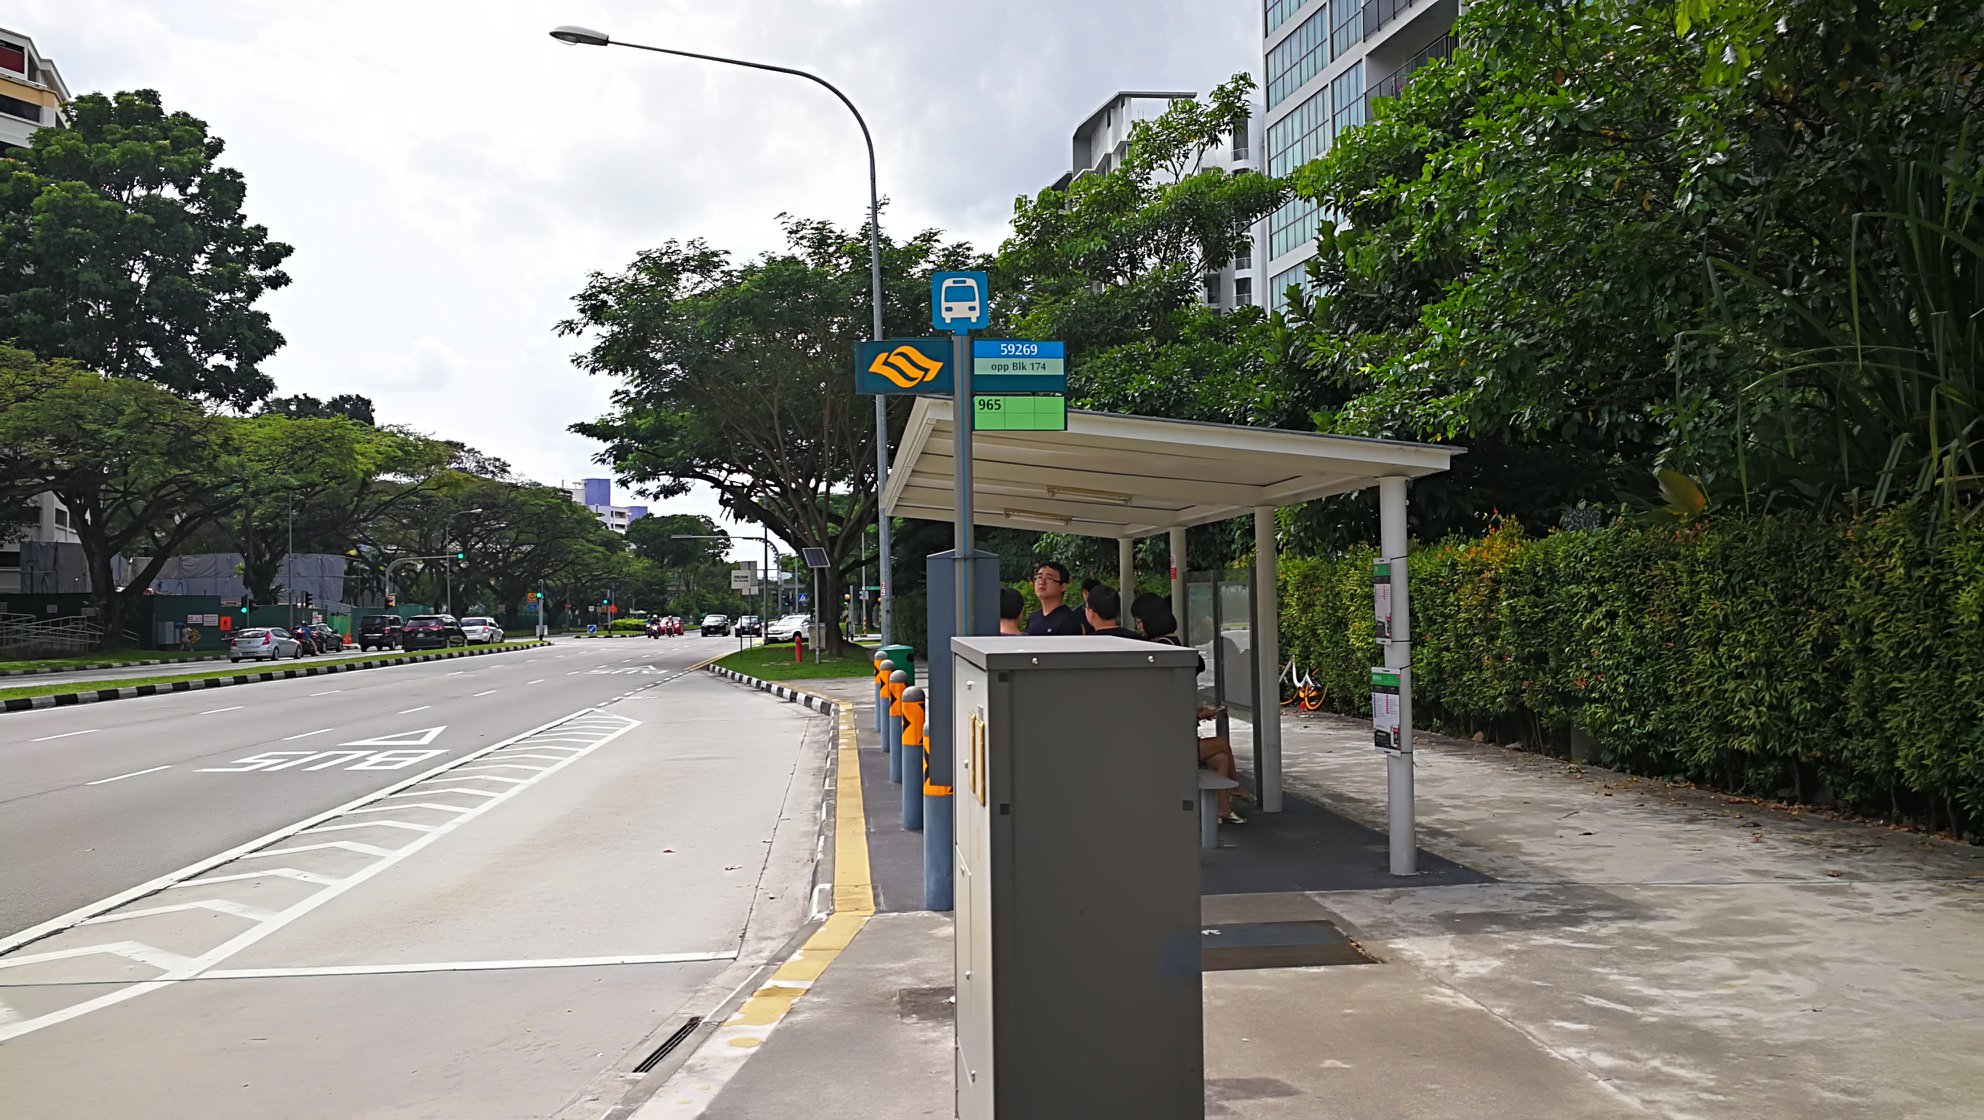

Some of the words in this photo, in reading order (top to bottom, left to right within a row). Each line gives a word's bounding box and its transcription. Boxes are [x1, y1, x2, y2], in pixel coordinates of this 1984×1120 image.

[1000, 343, 1038, 355] 59269
[991, 363, 1009, 372] opp
[1012, 362, 1027, 371] Blk
[1030, 362, 1046, 371] 174
[978, 399, 1001, 411] 965
[192, 750, 450, 772] BUS
